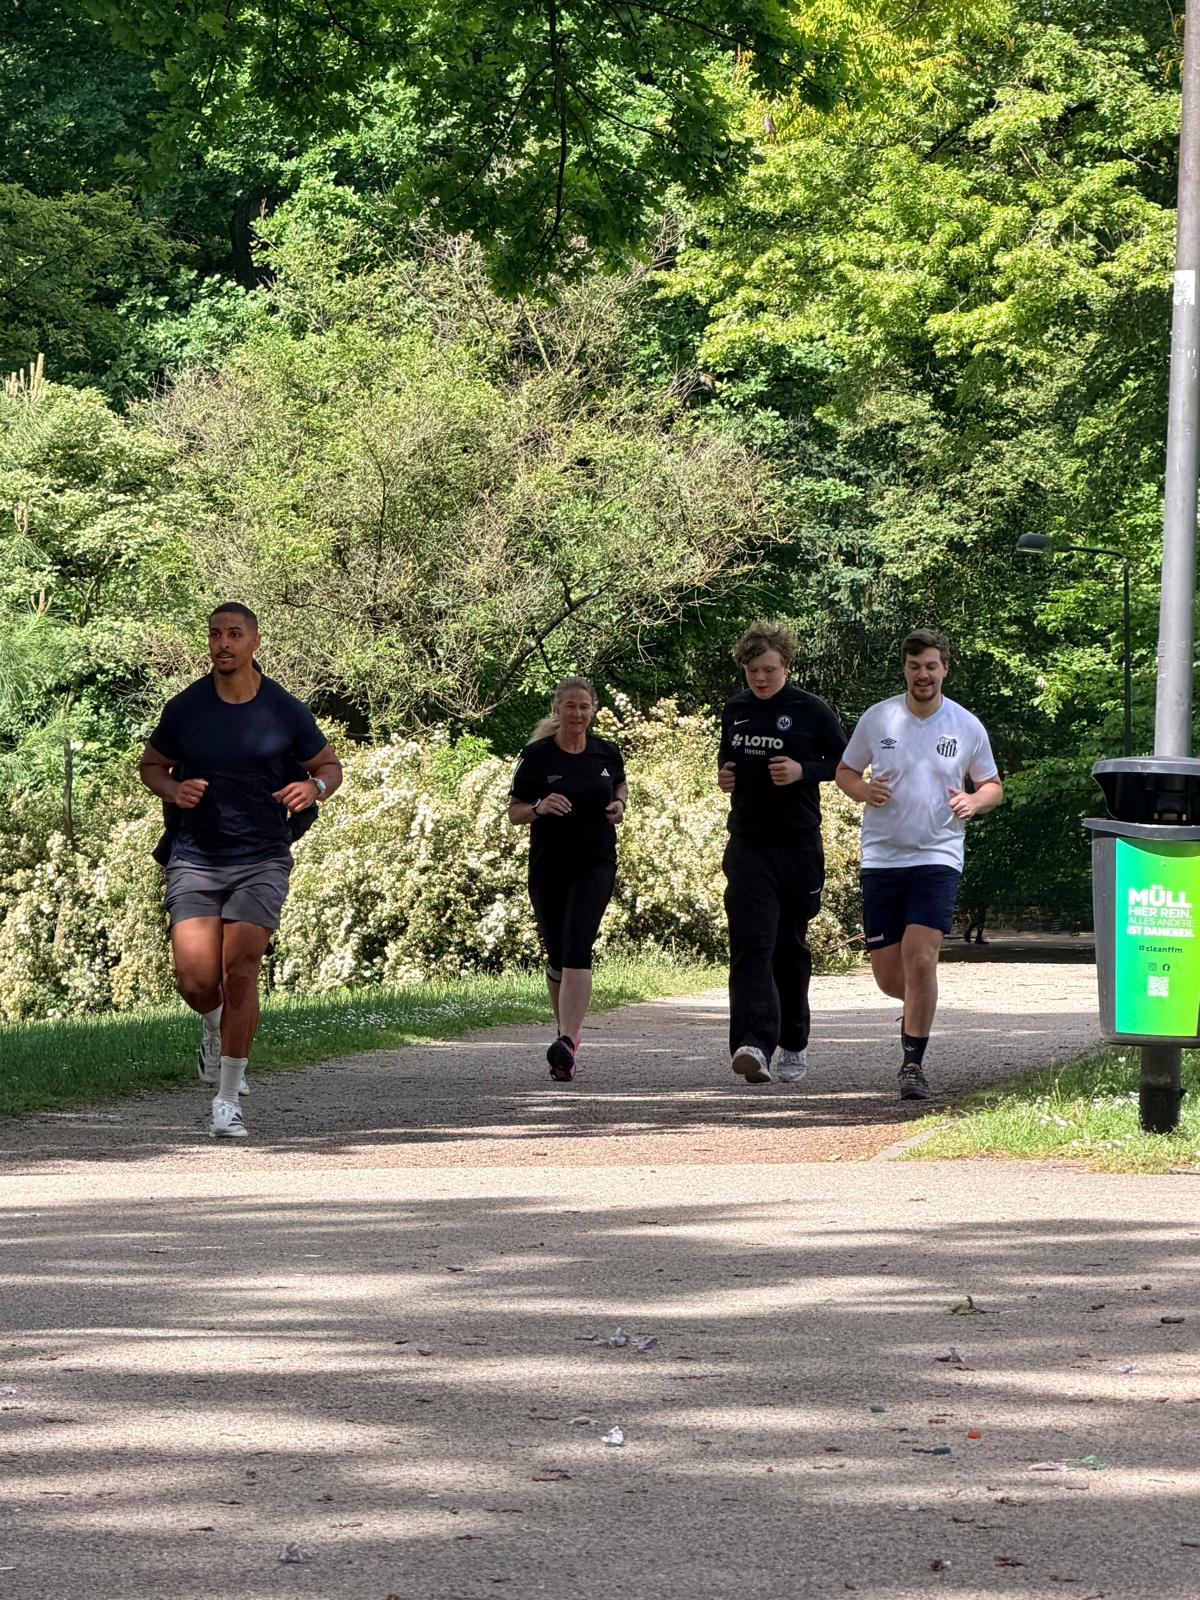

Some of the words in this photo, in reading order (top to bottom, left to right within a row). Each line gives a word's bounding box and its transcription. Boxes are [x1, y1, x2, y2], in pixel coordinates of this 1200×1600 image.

[744, 735, 784, 750] LOTTO
[744, 748, 766, 756] Hessen
[1128, 885, 1192, 908] MÜLL
[1128, 906, 1157, 917] HIER
[1160, 908, 1193, 919] REIN.
[1128, 917, 1155, 926] ALLES
[1157, 918, 1194, 928] ANDERE
[1138, 945, 1183, 953] #cleanffm
